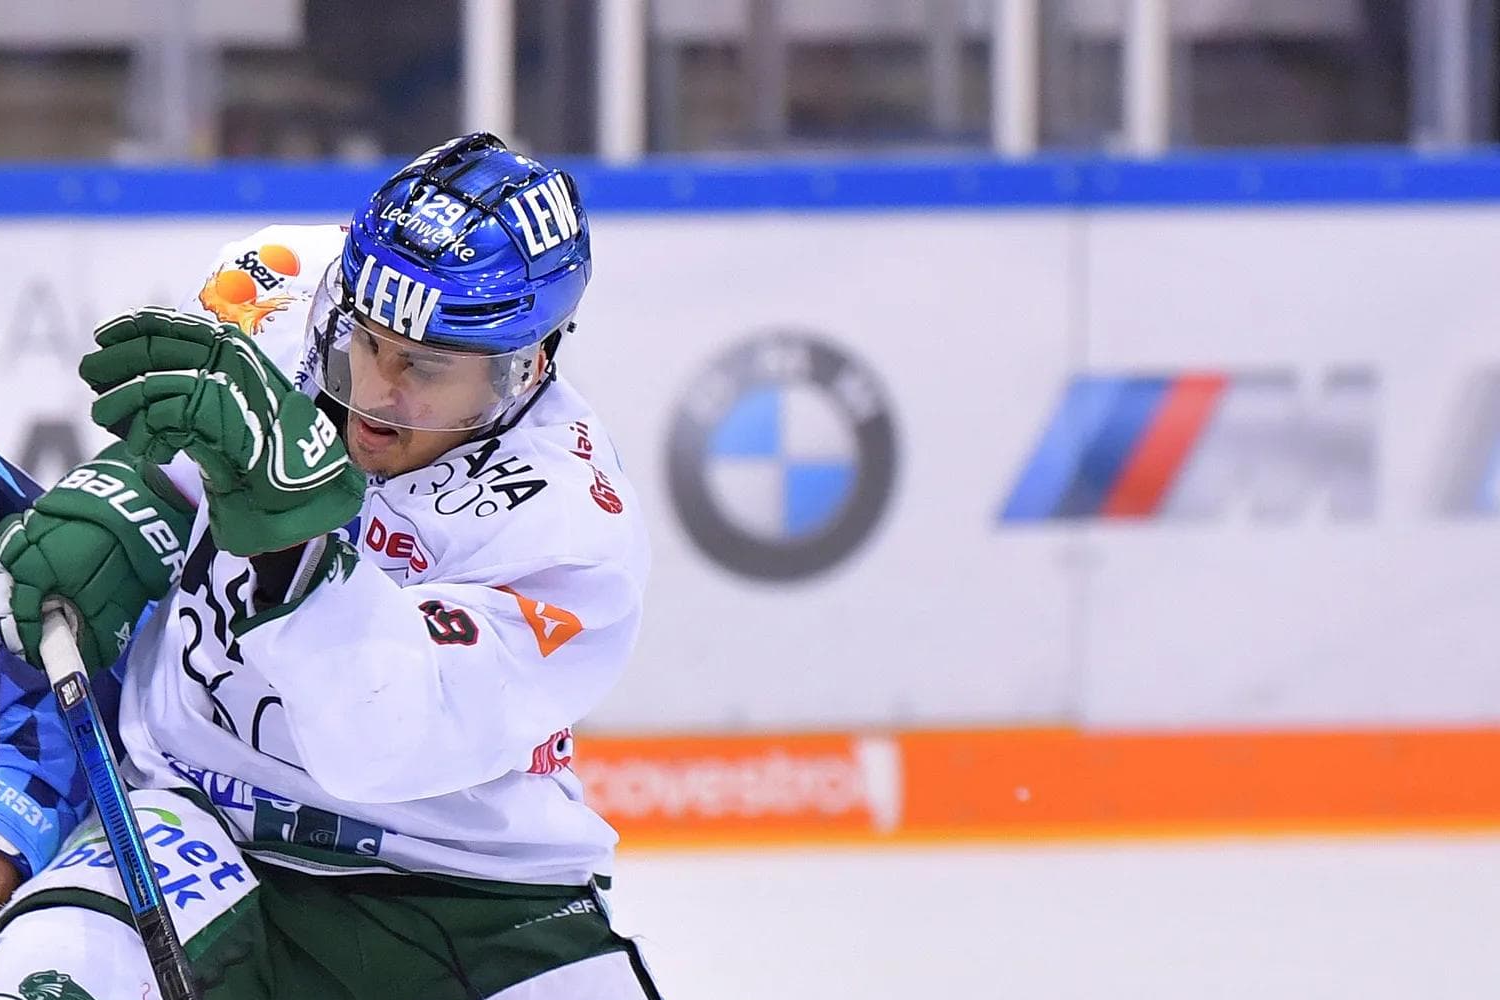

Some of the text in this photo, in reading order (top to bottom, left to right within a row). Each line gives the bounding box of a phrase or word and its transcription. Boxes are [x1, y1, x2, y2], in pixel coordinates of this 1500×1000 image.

[379, 201, 476, 262] Lechwerke
[420, 194, 467, 227] 29
[509, 173, 579, 257] LEW
[235, 250, 285, 292] Spezi
[355, 255, 442, 342] LEW
[59, 467, 187, 582] BAUER
[143, 823, 246, 891] net
